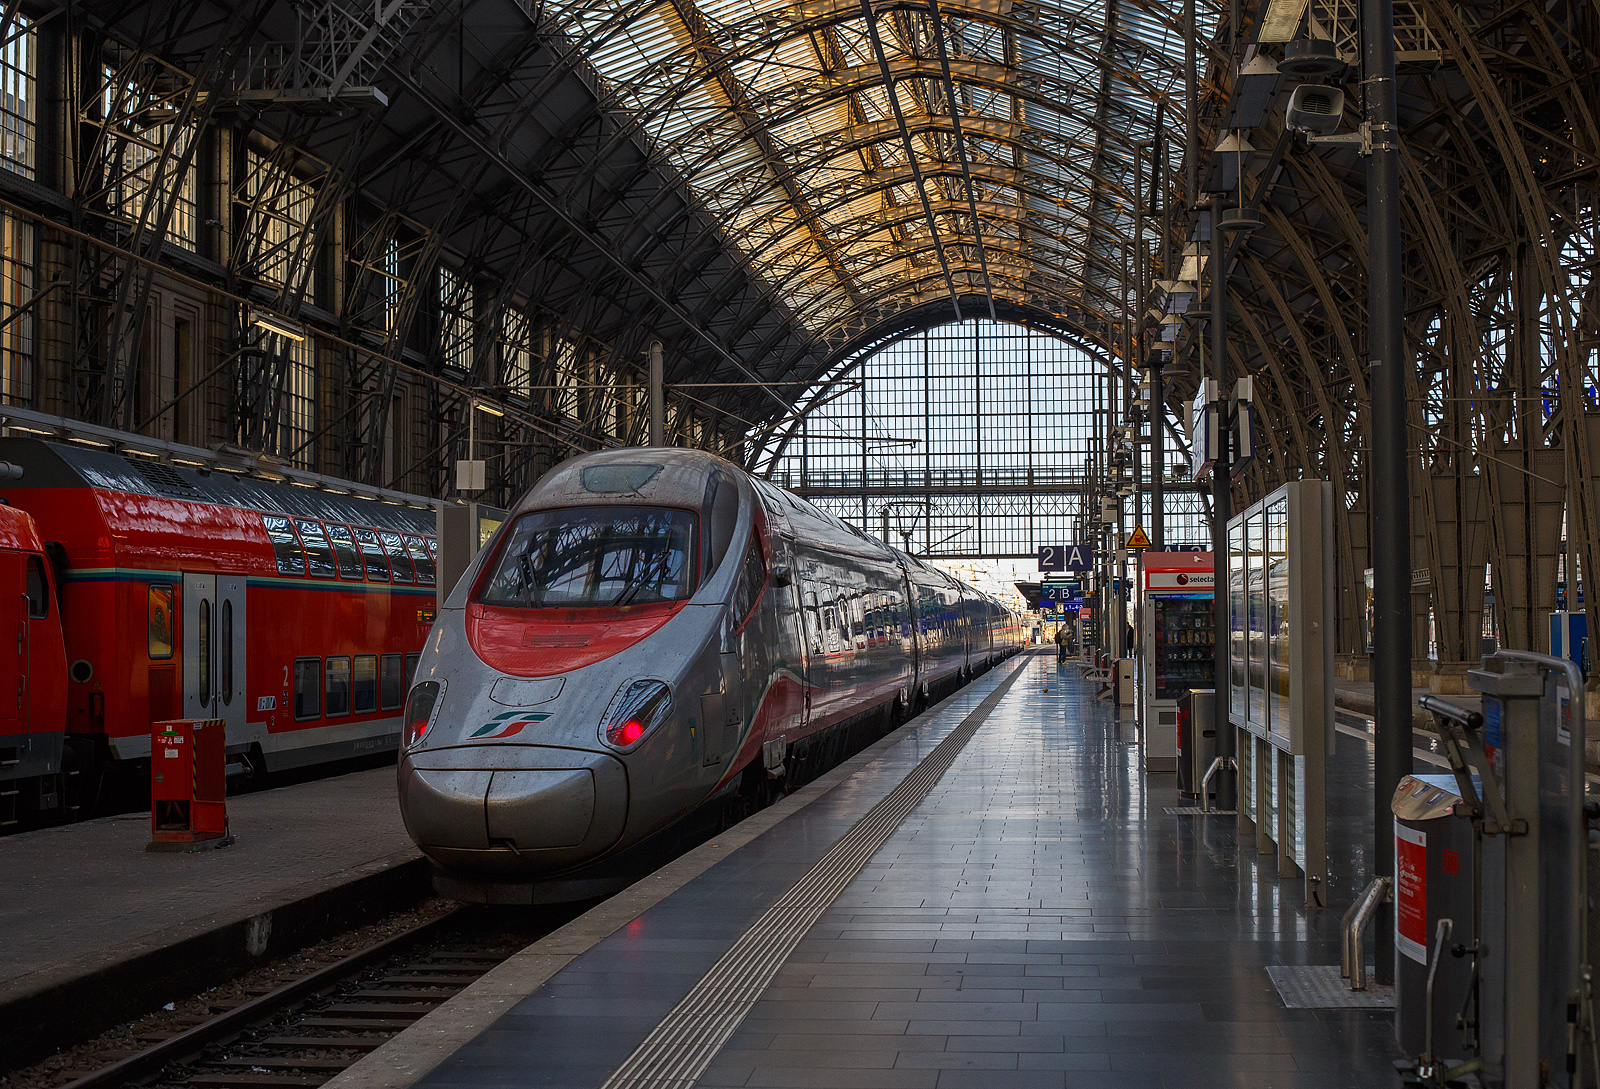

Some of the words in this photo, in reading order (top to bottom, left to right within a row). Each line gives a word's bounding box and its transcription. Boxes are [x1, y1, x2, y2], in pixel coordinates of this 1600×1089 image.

[1042, 547, 1055, 566] 2
[1068, 547, 1084, 566] A
[1189, 575, 1214, 583] selecta
[1048, 588, 1056, 599] 2
[1062, 588, 1070, 598] B
[1577, 583, 1583, 594] 4
[283, 665, 288, 687] 2
[1444, 852, 1458, 873] DB
